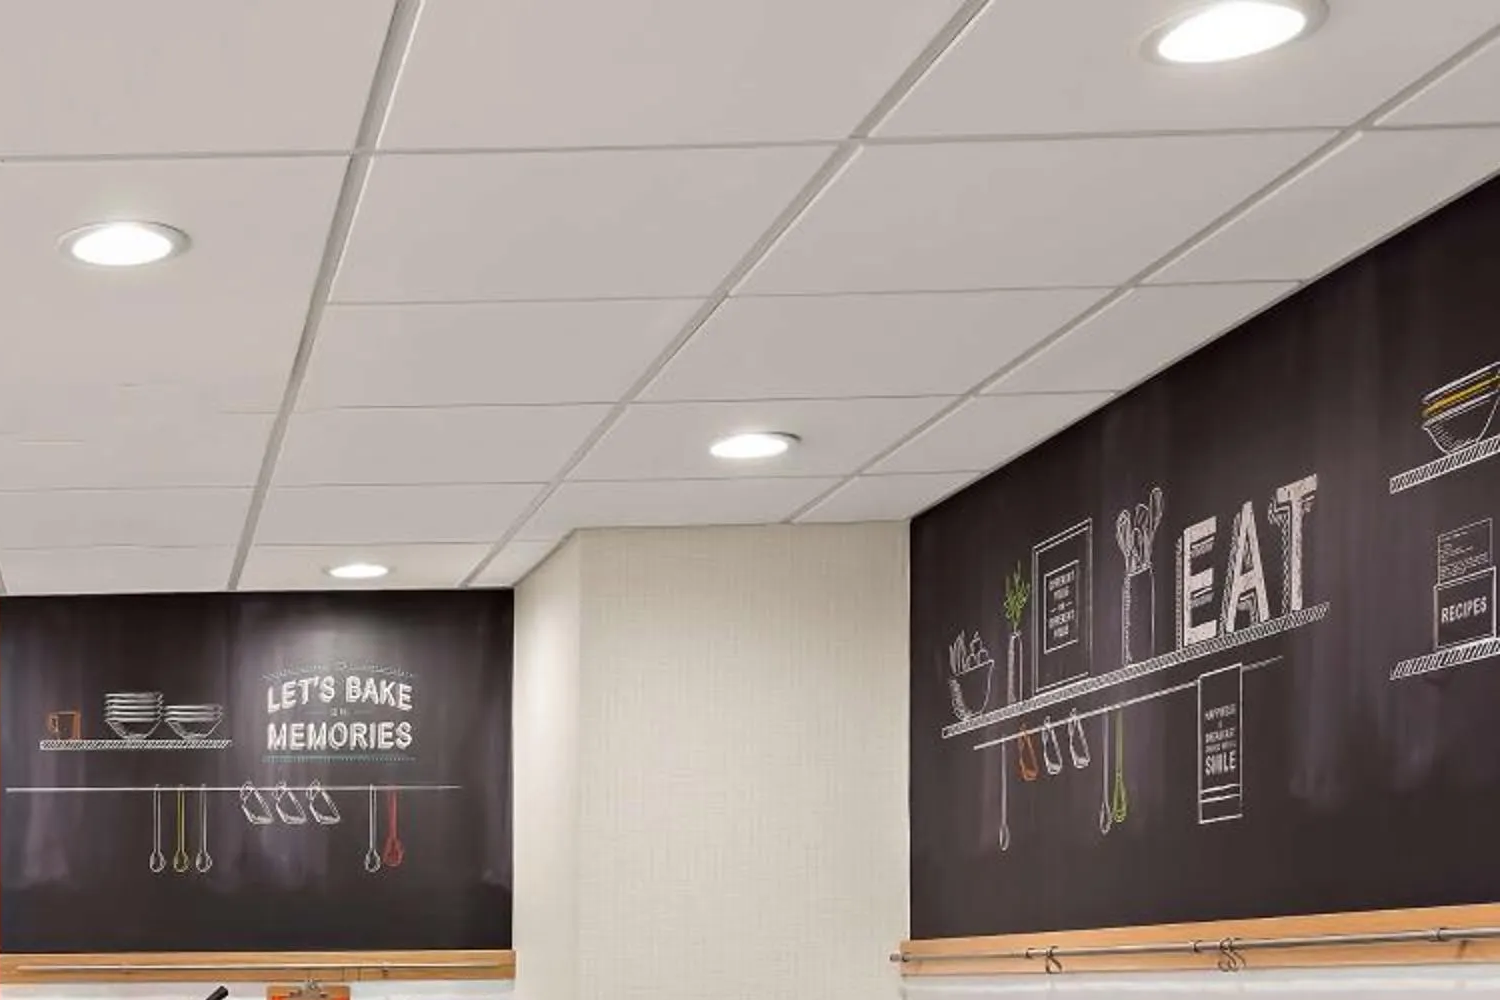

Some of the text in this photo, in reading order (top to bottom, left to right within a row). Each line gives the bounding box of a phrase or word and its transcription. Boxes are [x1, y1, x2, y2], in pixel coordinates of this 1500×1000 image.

[1176, 472, 1318, 649] EAT
[1441, 596, 1488, 623] RECIPES
[267, 675, 413, 714] LET'S BAKE
[267, 721, 413, 751] MEMORIES
